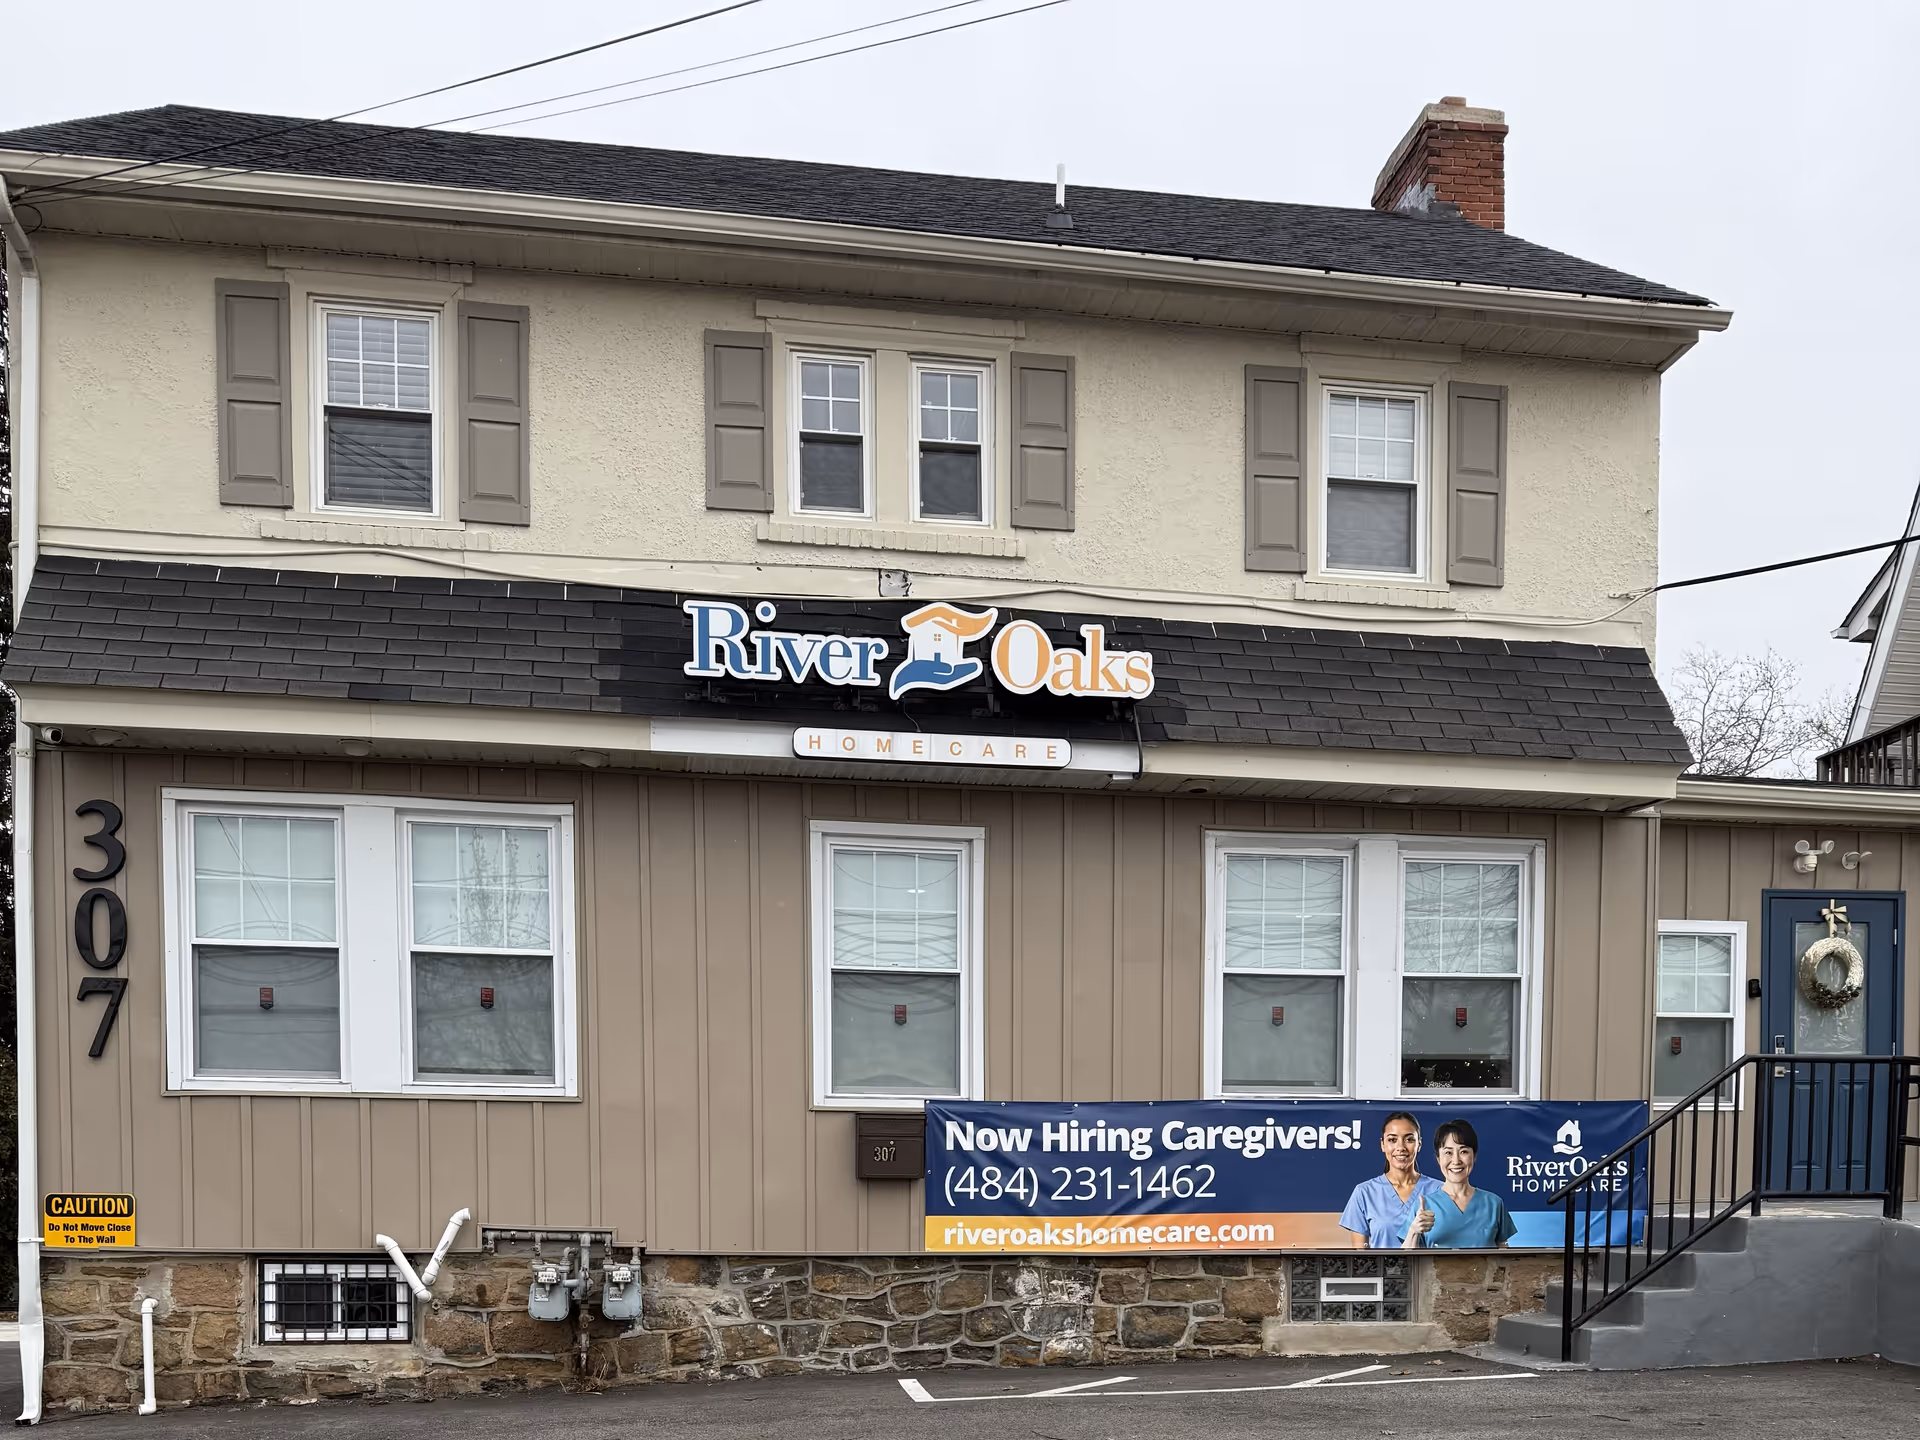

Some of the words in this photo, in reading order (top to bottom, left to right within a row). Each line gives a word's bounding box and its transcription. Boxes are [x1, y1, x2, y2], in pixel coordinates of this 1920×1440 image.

[684, 601, 890, 687] River
[994, 619, 1153, 695] Oaks
[807, 734, 1058, 761] HOMECARE
[73, 799, 129, 1058] 307
[944, 1120, 1032, 1153] Now
[1042, 1119, 1153, 1160] Hiring
[1161, 1117, 1363, 1158] Caregivers!
[874, 1146, 896, 1162] 307
[944, 1166, 1039, 1207] (484)
[1050, 1164, 1217, 1201] 231-1462
[1512, 1179, 1622, 1193] HOMEARE
[51, 1197, 128, 1214] CAUTION
[48, 1223, 60, 1232] Do
[63, 1223, 78, 1232] Not
[81, 1223, 105, 1232] Move
[107, 1223, 131, 1232] Close
[944, 1223, 1275, 1246] riveroakshomecare.com
[64, 1235, 75, 1244] To
[78, 1235, 94, 1244] The
[96, 1235, 115, 1244] Wall
